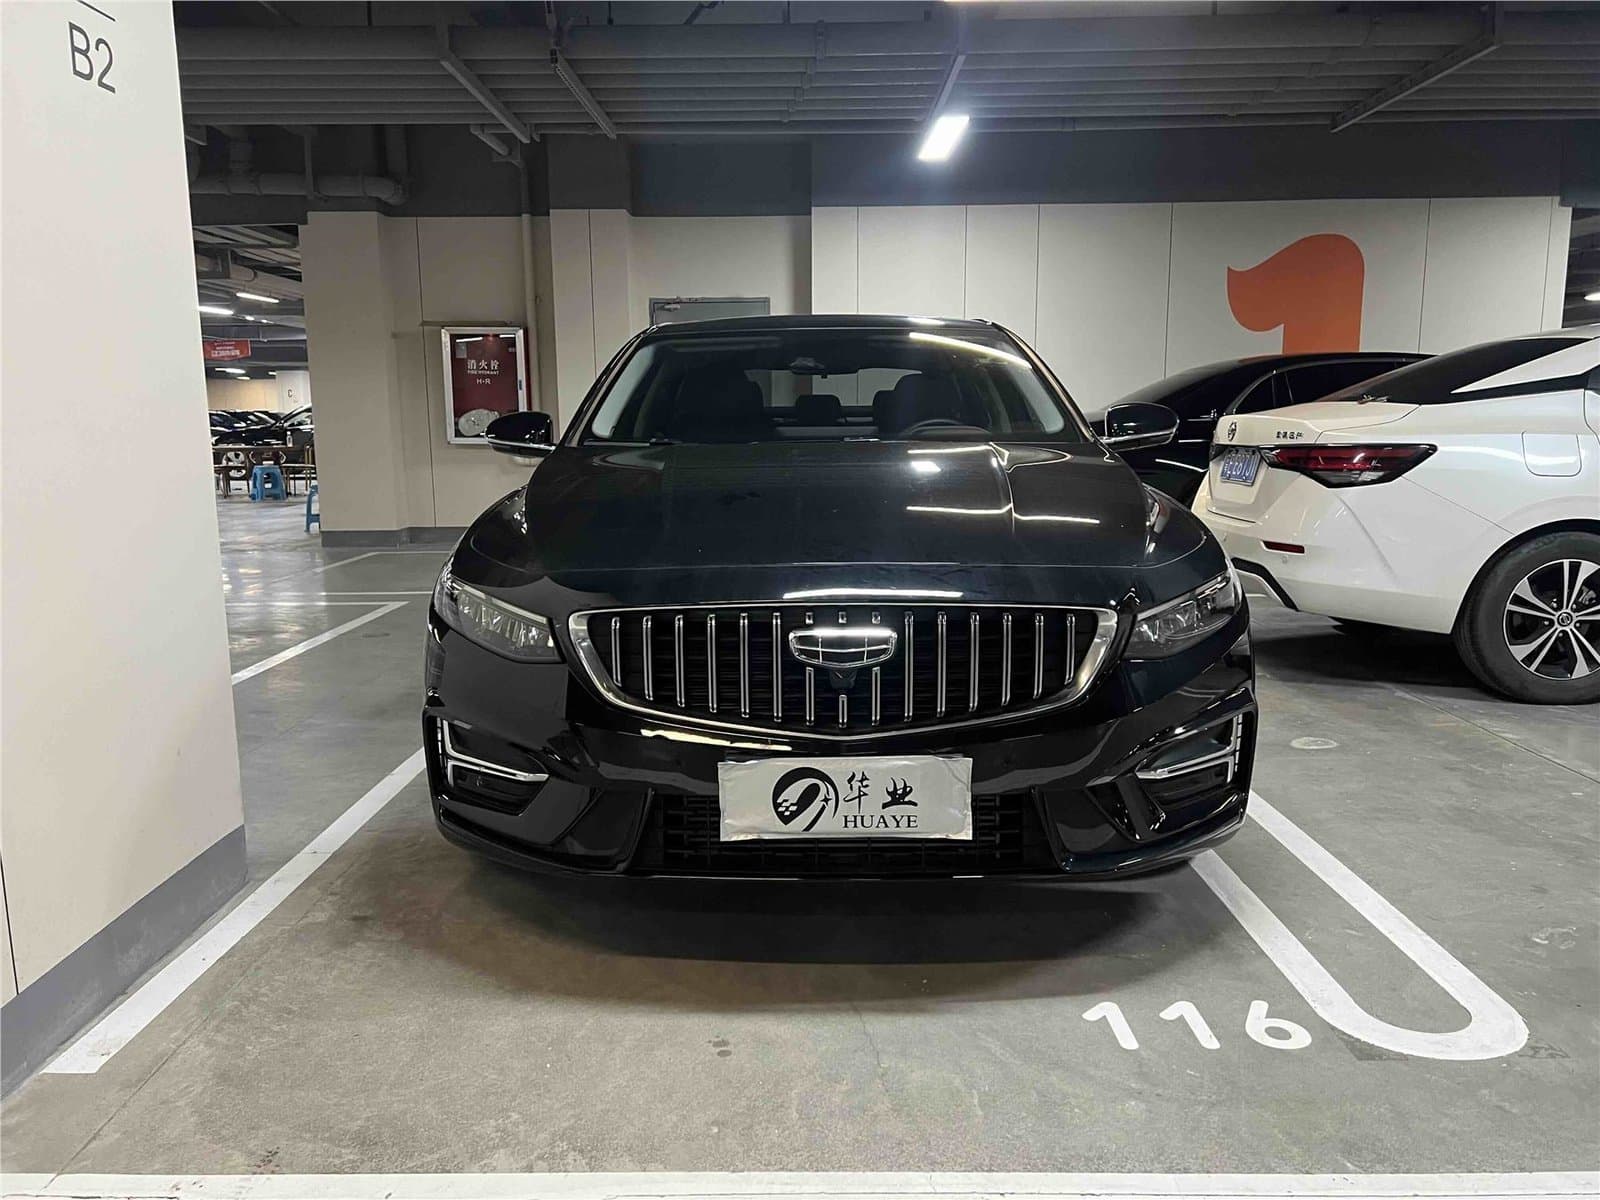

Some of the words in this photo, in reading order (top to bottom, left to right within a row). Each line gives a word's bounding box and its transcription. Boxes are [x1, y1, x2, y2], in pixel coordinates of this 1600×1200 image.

[68, 21, 116, 94] B2
[843, 771, 918, 814] 华业
[843, 815, 919, 829] HUAYE
[1081, 1000, 1312, 1050] 116
